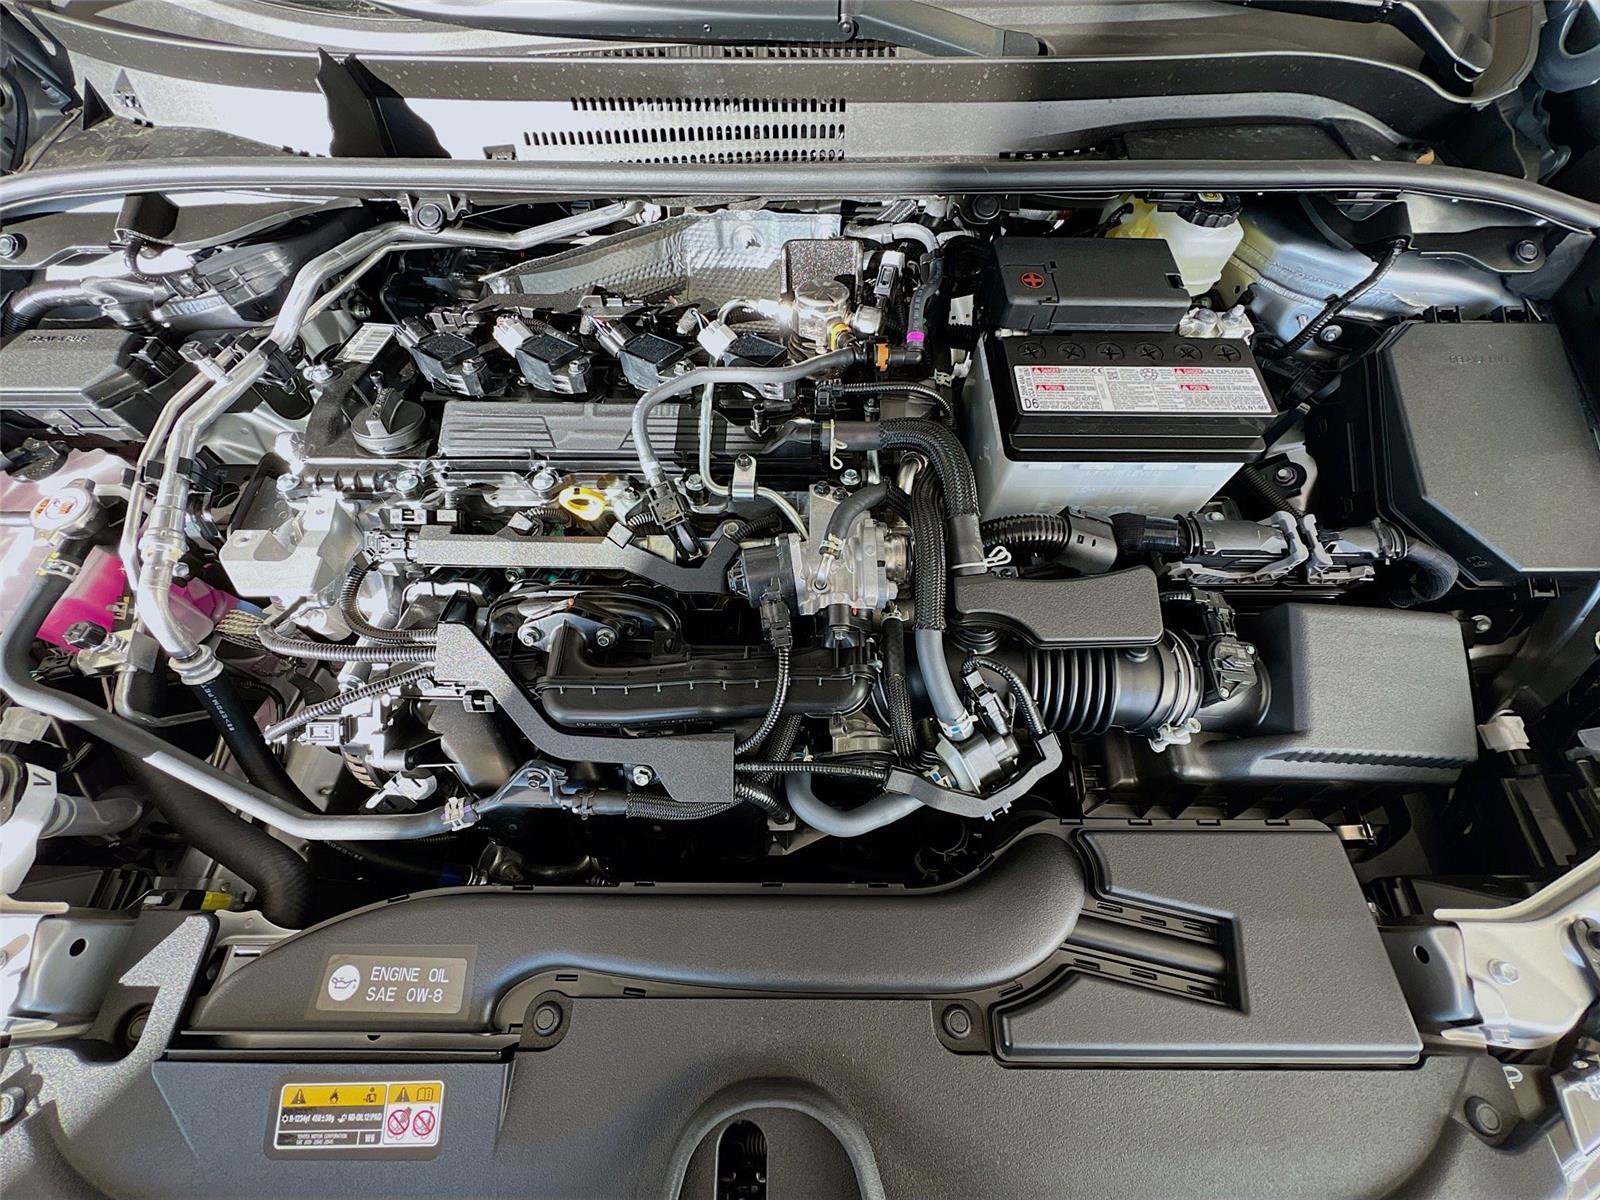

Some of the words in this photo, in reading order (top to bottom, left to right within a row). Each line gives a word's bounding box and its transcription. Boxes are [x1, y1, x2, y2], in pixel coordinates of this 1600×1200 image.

[1024, 398, 1040, 409] D6
[370, 966, 421, 982] ENGINE
[428, 968, 449, 983] OIL
[365, 987, 398, 1002] SAE
[406, 988, 443, 1003] 0W-8
